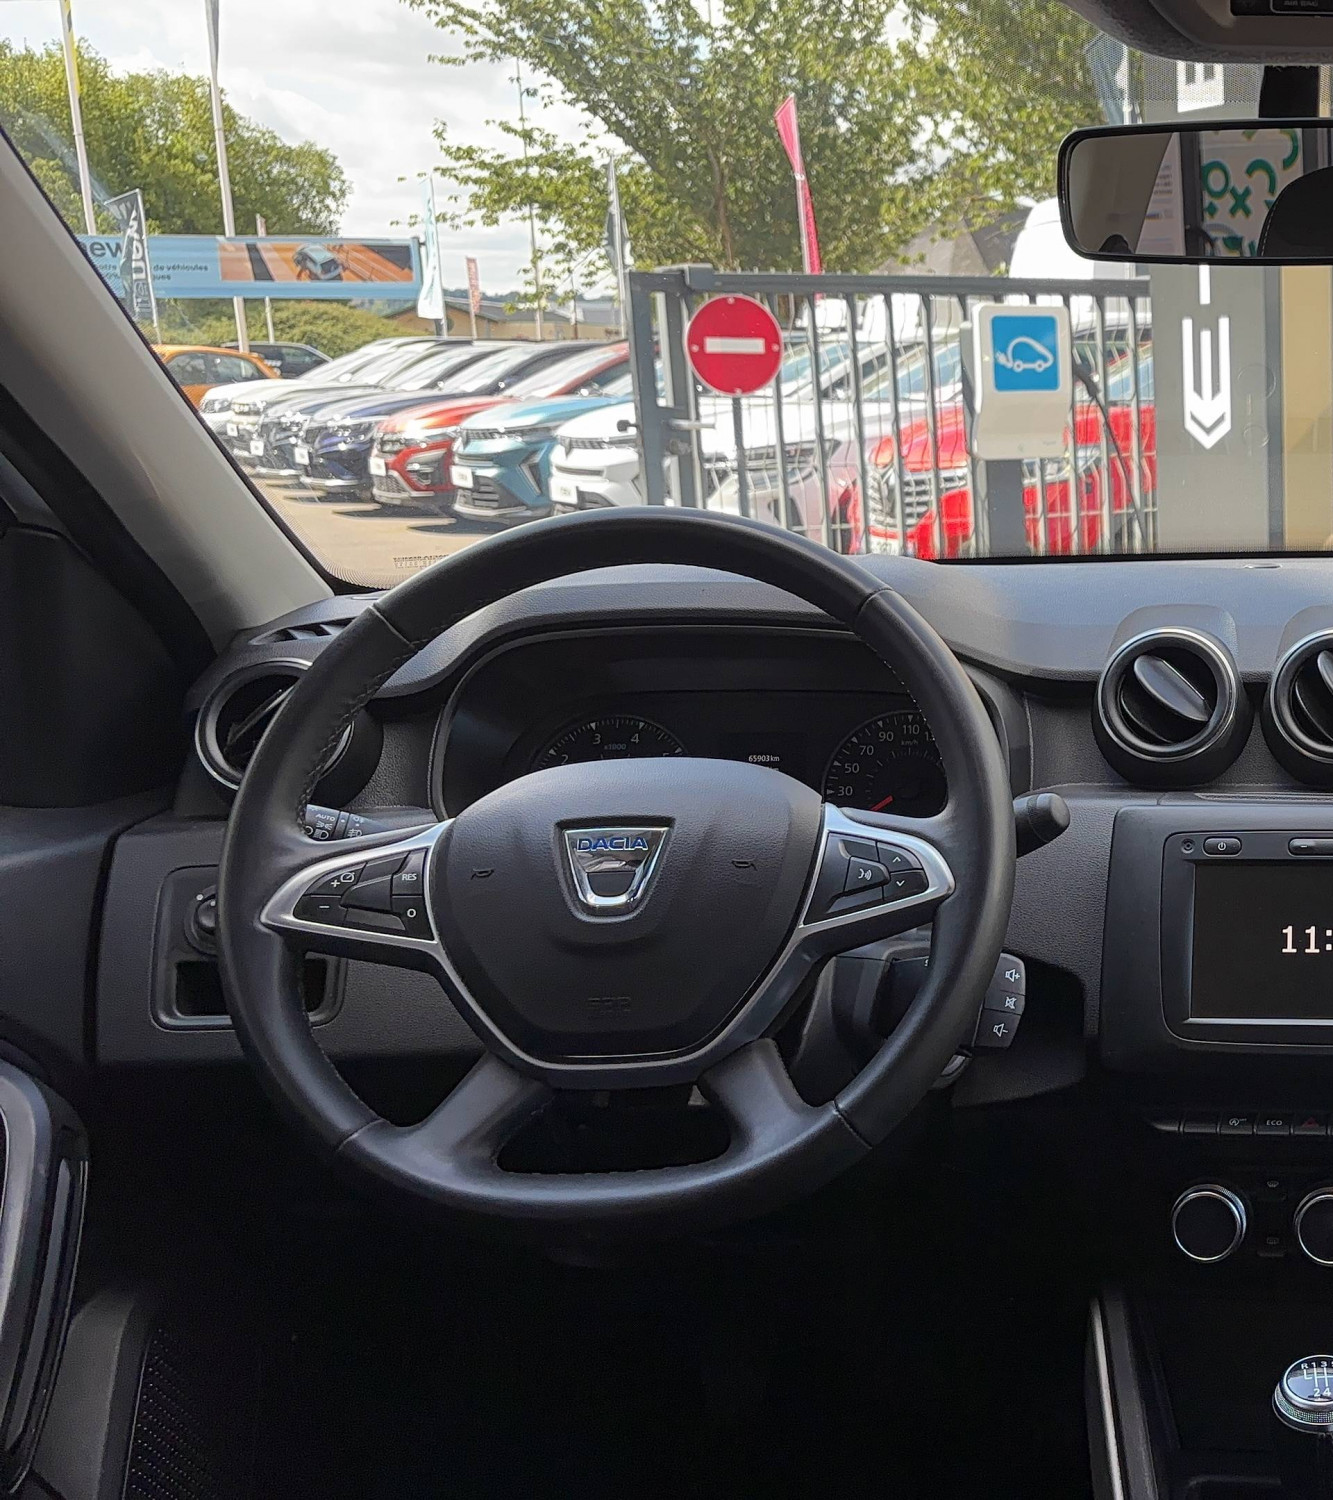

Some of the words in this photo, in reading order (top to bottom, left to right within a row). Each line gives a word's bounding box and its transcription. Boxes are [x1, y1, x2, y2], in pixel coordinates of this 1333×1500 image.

[902, 724, 920, 735] 110
[593, 733, 601, 745] 3
[630, 733, 640, 744] 4
[878, 731, 894, 742] 90
[859, 745, 874, 756] 70
[770, 754, 780, 762] km
[844, 763, 860, 774] 50
[837, 786, 853, 796] 30
[315, 813, 336, 821] AUTO
[577, 837, 648, 852] DACIA
[401, 873, 417, 881] RES
[1313, 1388, 1320, 1397] 2
[1322, 1387, 1332, 1396] 4
